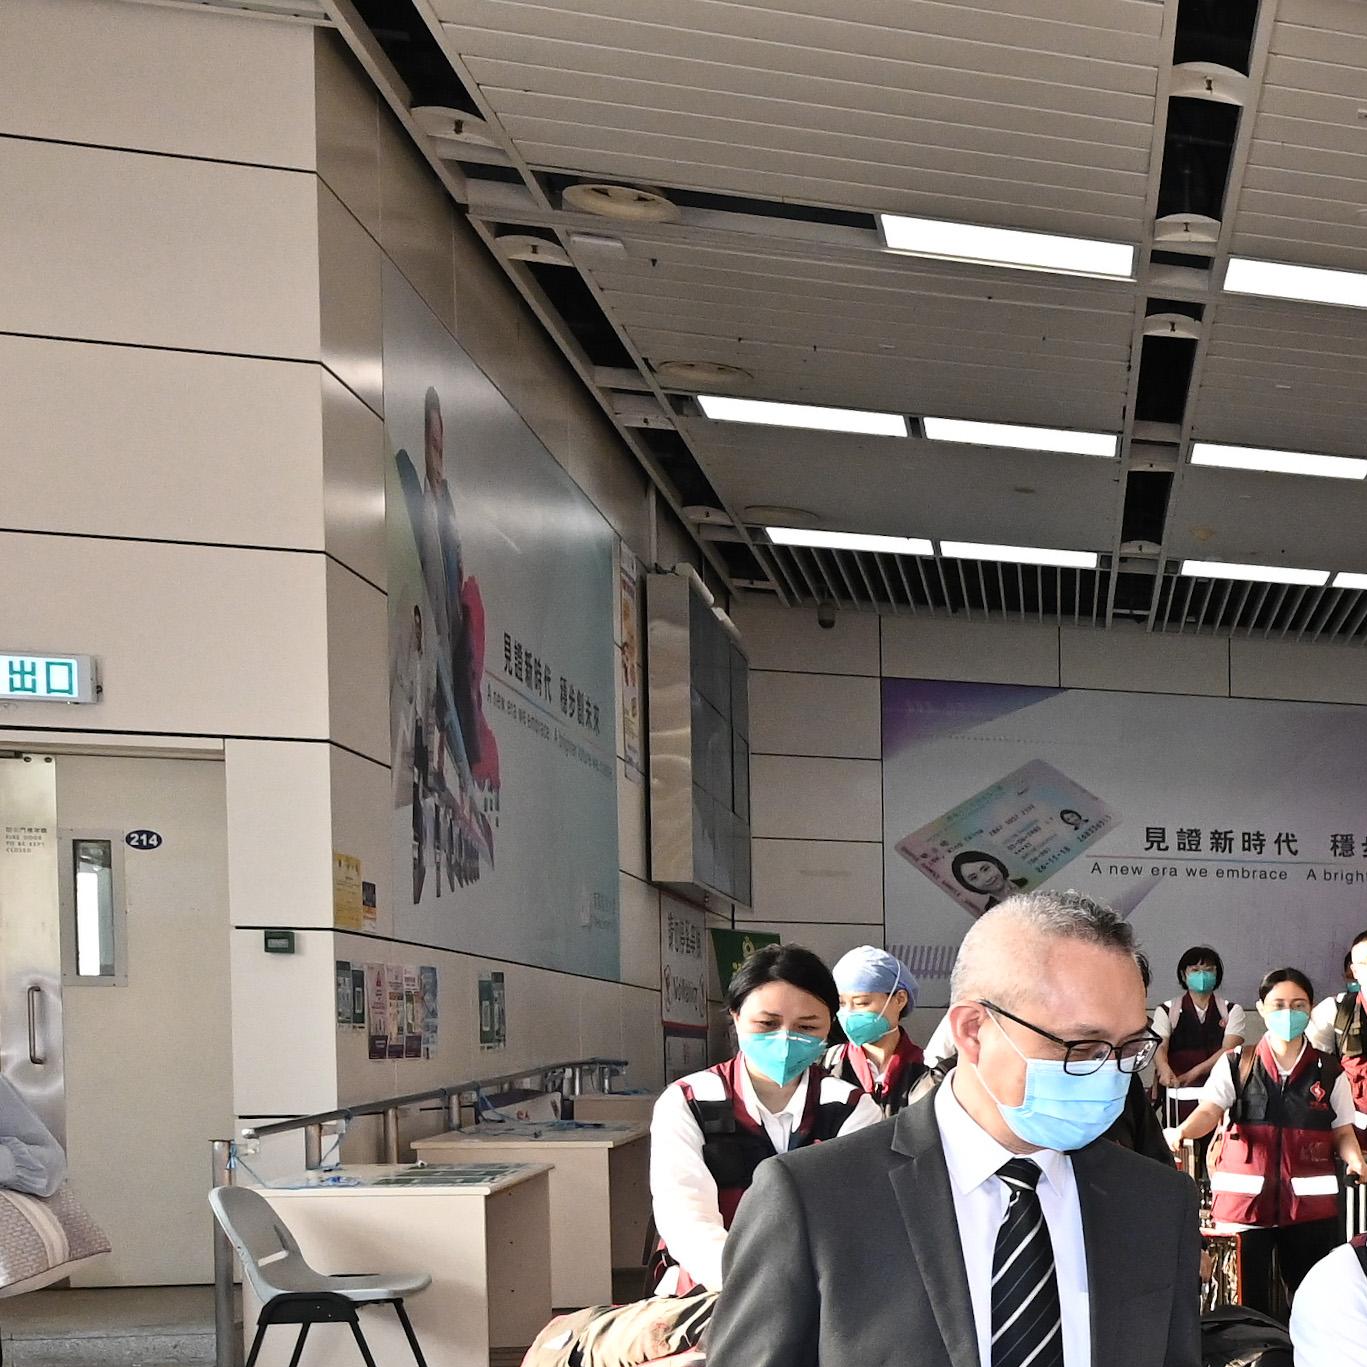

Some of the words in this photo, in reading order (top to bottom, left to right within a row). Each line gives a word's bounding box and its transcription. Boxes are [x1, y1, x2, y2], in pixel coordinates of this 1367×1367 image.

[9, 660, 73, 695] 出口
[128, 832, 159, 847] 214
[1144, 826, 1299, 856] 見證新時代
[1091, 862, 1102, 875] A
[1109, 864, 1143, 876] new
[1151, 867, 1178, 878] era
[1186, 867, 1208, 879] we
[1216, 866, 1288, 881] embrace
[1306, 868, 1317, 881] A
